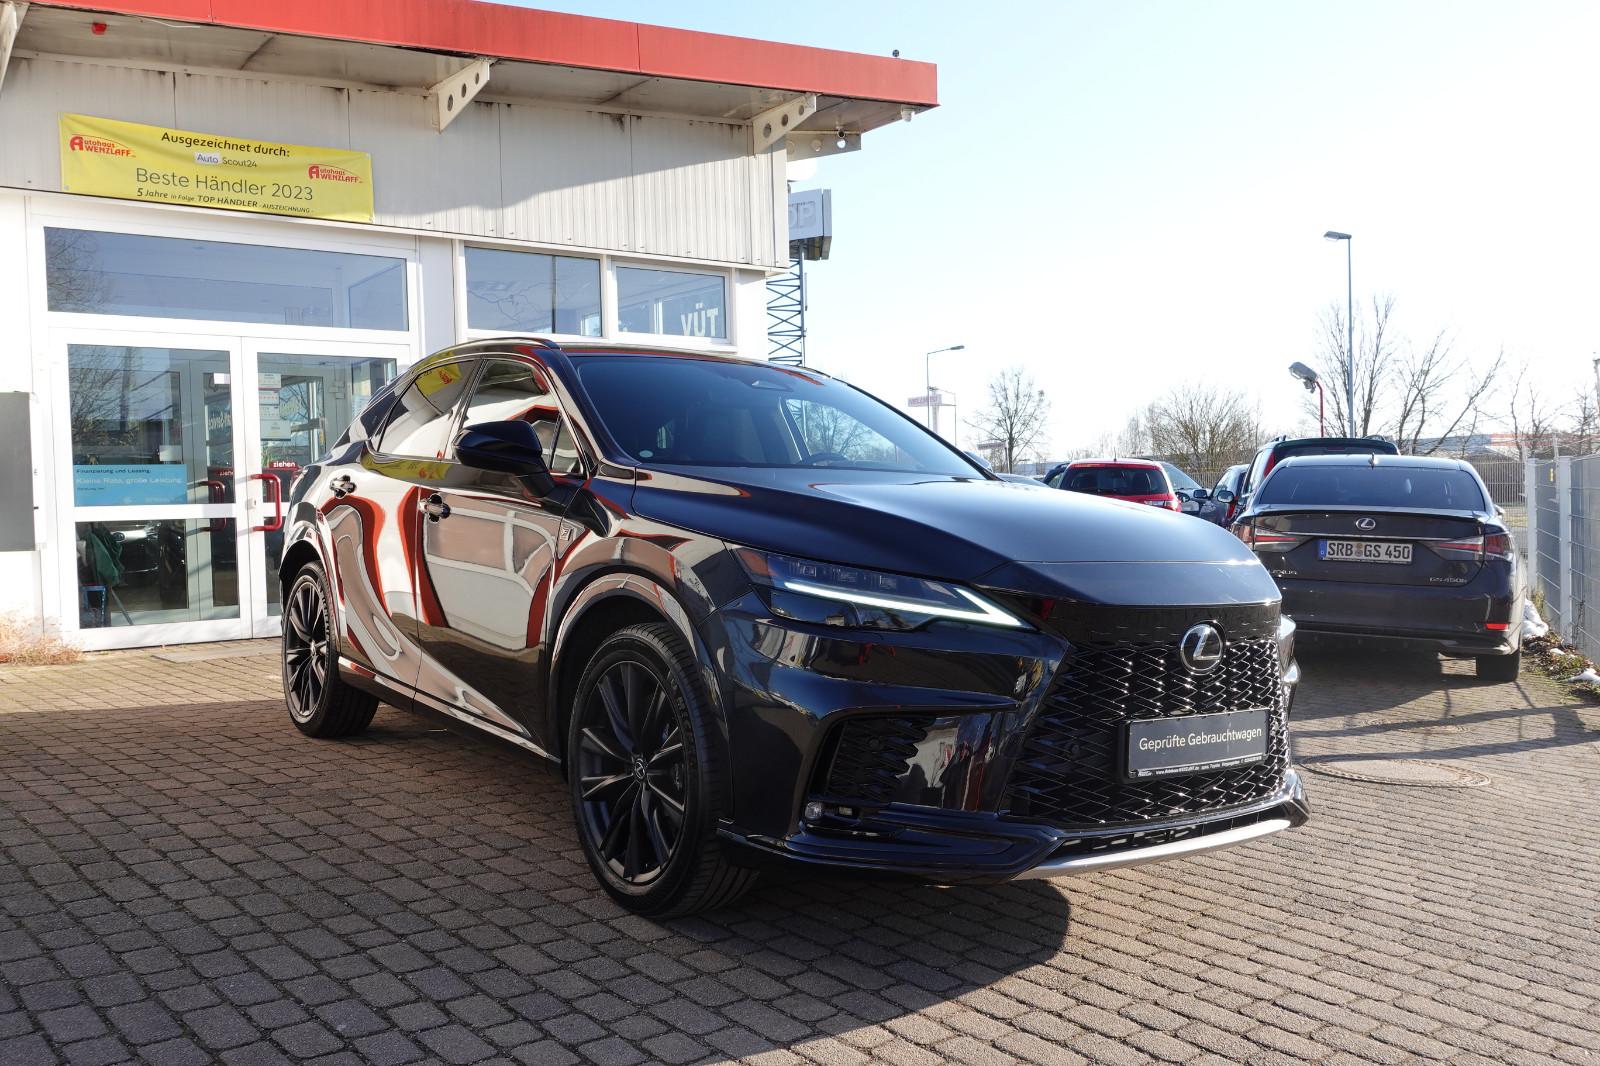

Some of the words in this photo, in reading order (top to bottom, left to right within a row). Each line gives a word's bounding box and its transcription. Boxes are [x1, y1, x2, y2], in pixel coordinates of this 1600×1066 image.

[85, 145, 132, 157] WENZLAFF
[161, 132, 251, 153] Ausgezeichnet
[254, 143, 290, 157] durch:
[197, 153, 219, 164] Auto
[222, 156, 257, 168] Scout24
[137, 167, 189, 188] Beste
[196, 175, 267, 195] Händler
[272, 183, 313, 201] 2023
[320, 173, 359, 183] WENZLAFF
[137, 188, 144, 199] 5
[145, 190, 168, 199] Jahre
[198, 194, 215, 204] TOP
[217, 195, 258, 208] HÄNDLER
[262, 203, 309, 214] AUSZEICHNUNG
[273, 460, 296, 468] ziehen
[1327, 539, 1354, 558] SRB
[1364, 542, 1381, 559] GS
[1385, 543, 1410, 560] 450
[1139, 735, 1186, 752] Geprüfte
[1187, 727, 1262, 747] Gebrauchtwagen
